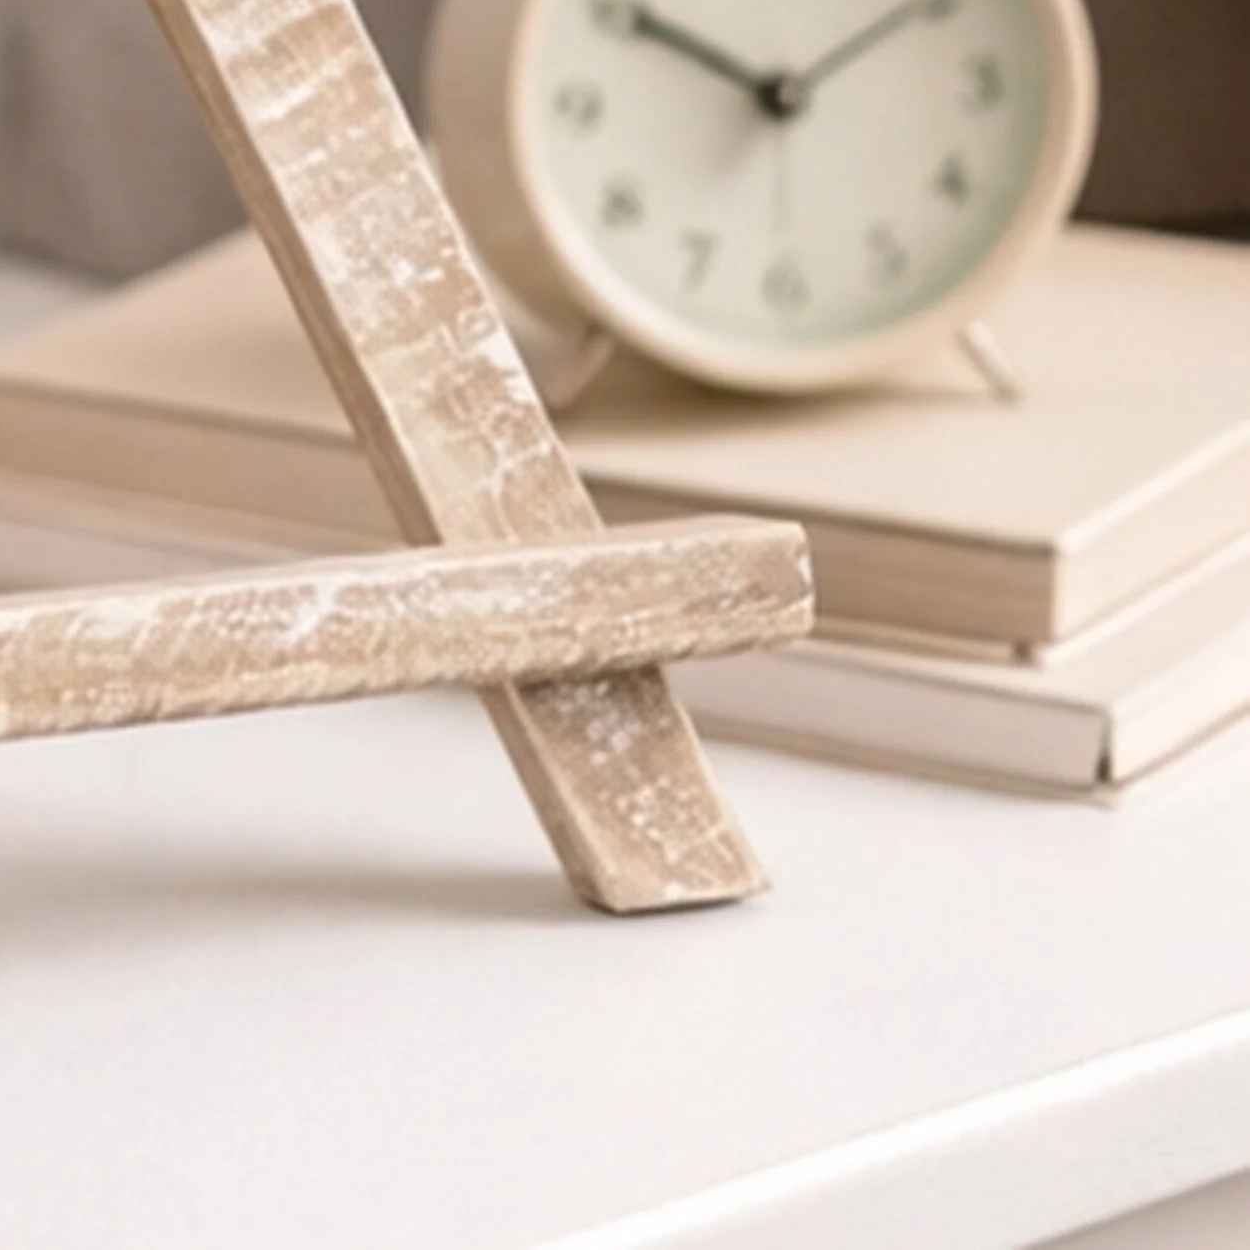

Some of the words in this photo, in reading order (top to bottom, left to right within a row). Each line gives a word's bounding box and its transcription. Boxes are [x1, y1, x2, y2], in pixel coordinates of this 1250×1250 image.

[552, 81, 605, 138] 9
[960, 53, 1005, 115] 3
[934, 153, 970, 212] 4
[679, 228, 721, 292] 7
